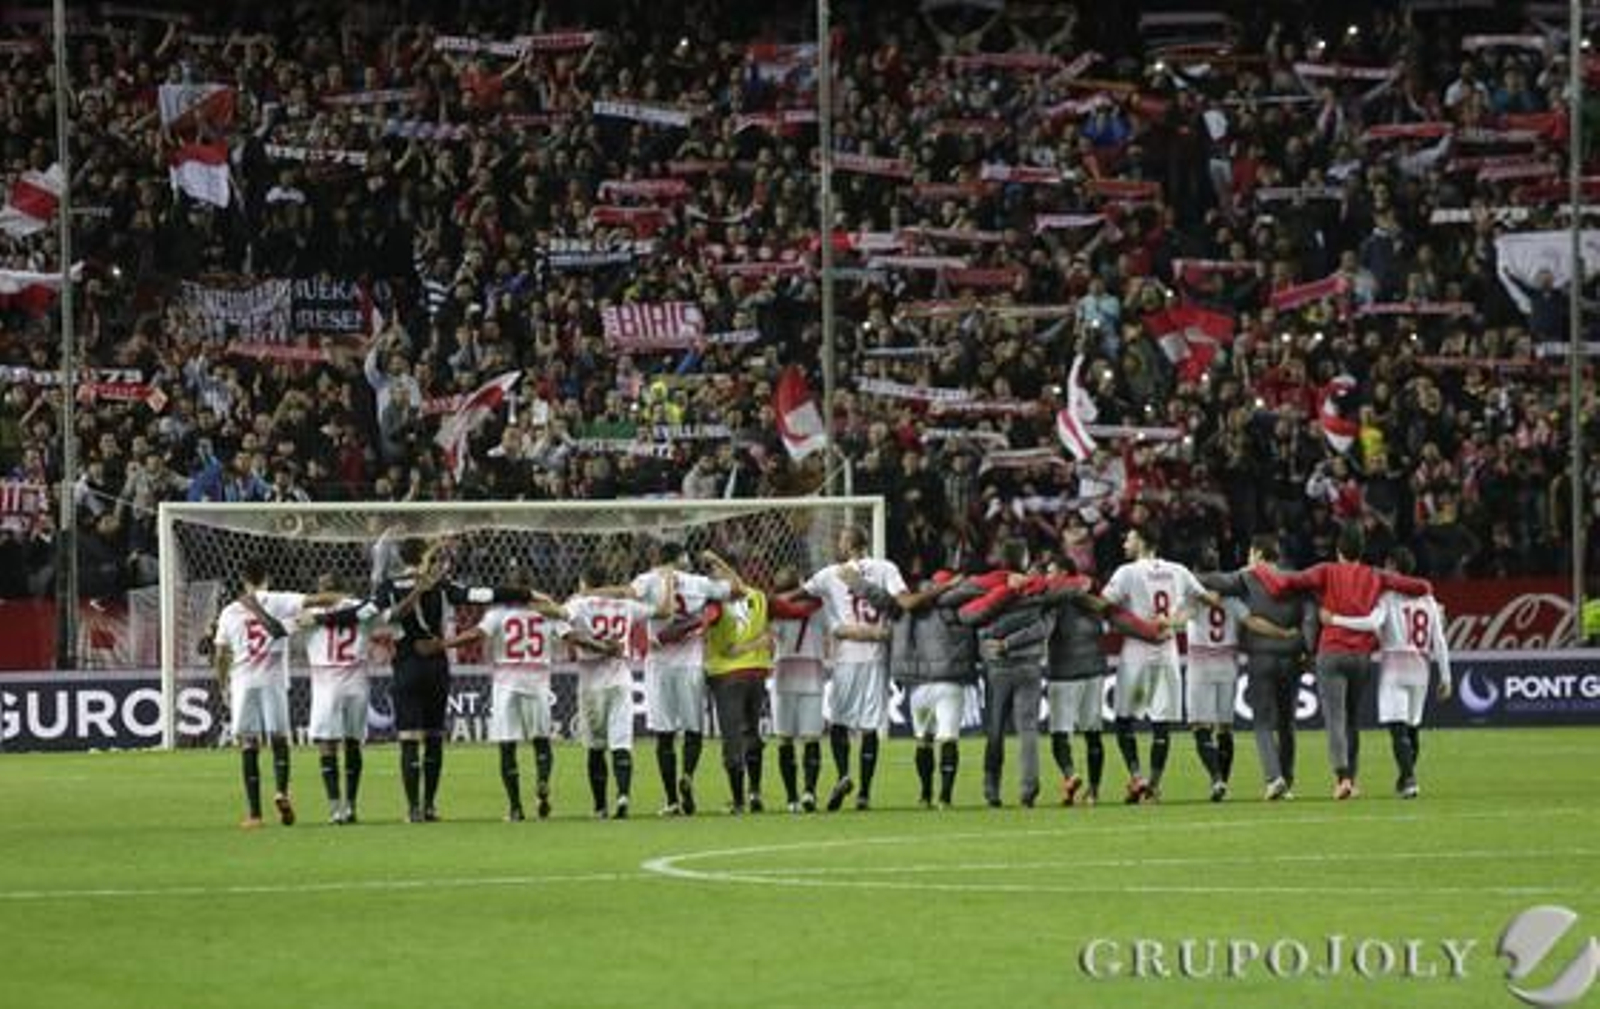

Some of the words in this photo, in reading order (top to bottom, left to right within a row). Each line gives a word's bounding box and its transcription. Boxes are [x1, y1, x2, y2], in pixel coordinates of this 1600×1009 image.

[245, 619, 269, 658] 5
[325, 615, 358, 663] 12
[504, 616, 546, 659] 25
[1209, 607, 1226, 643] 9
[1403, 606, 1429, 649] 18
[1504, 675, 1577, 698] PONT
